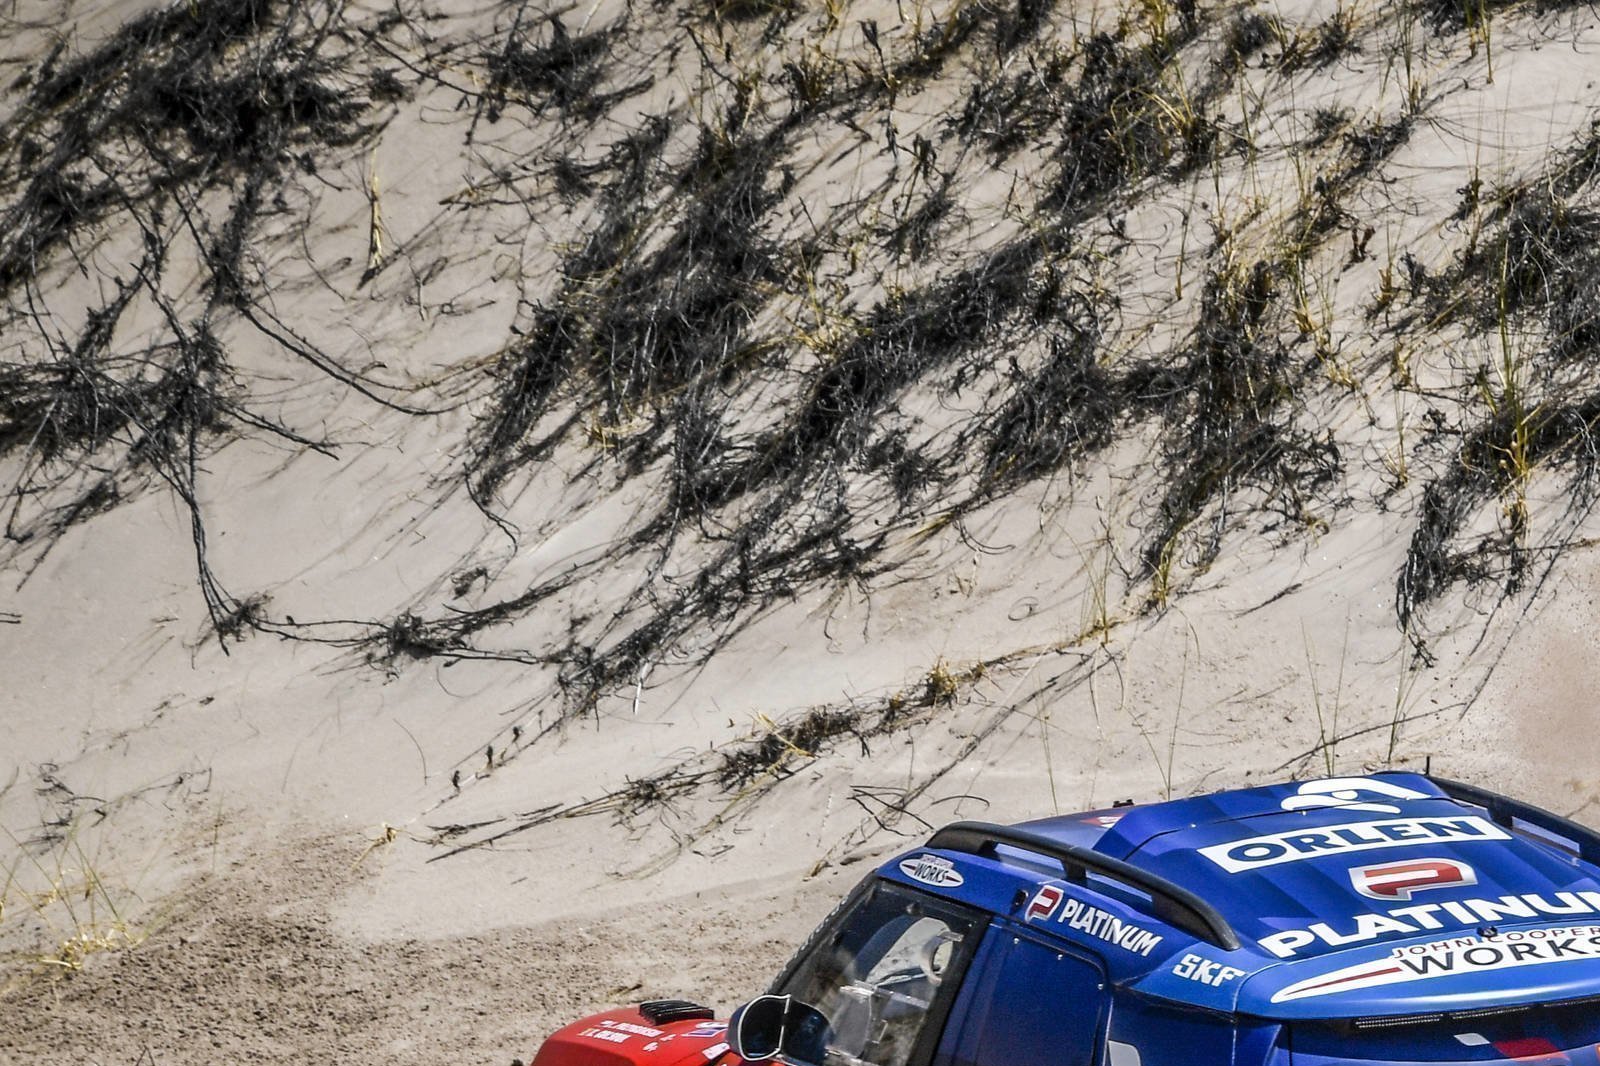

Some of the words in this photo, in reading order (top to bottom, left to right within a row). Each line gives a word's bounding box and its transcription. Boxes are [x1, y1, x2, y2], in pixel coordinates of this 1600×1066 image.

[1227, 818, 1488, 861] ORLEN
[914, 862, 949, 883] WORKS
[1058, 898, 1162, 957] PLATINUM
[1394, 938, 1474, 958] JOHN
[1172, 953, 1247, 987] SKF
